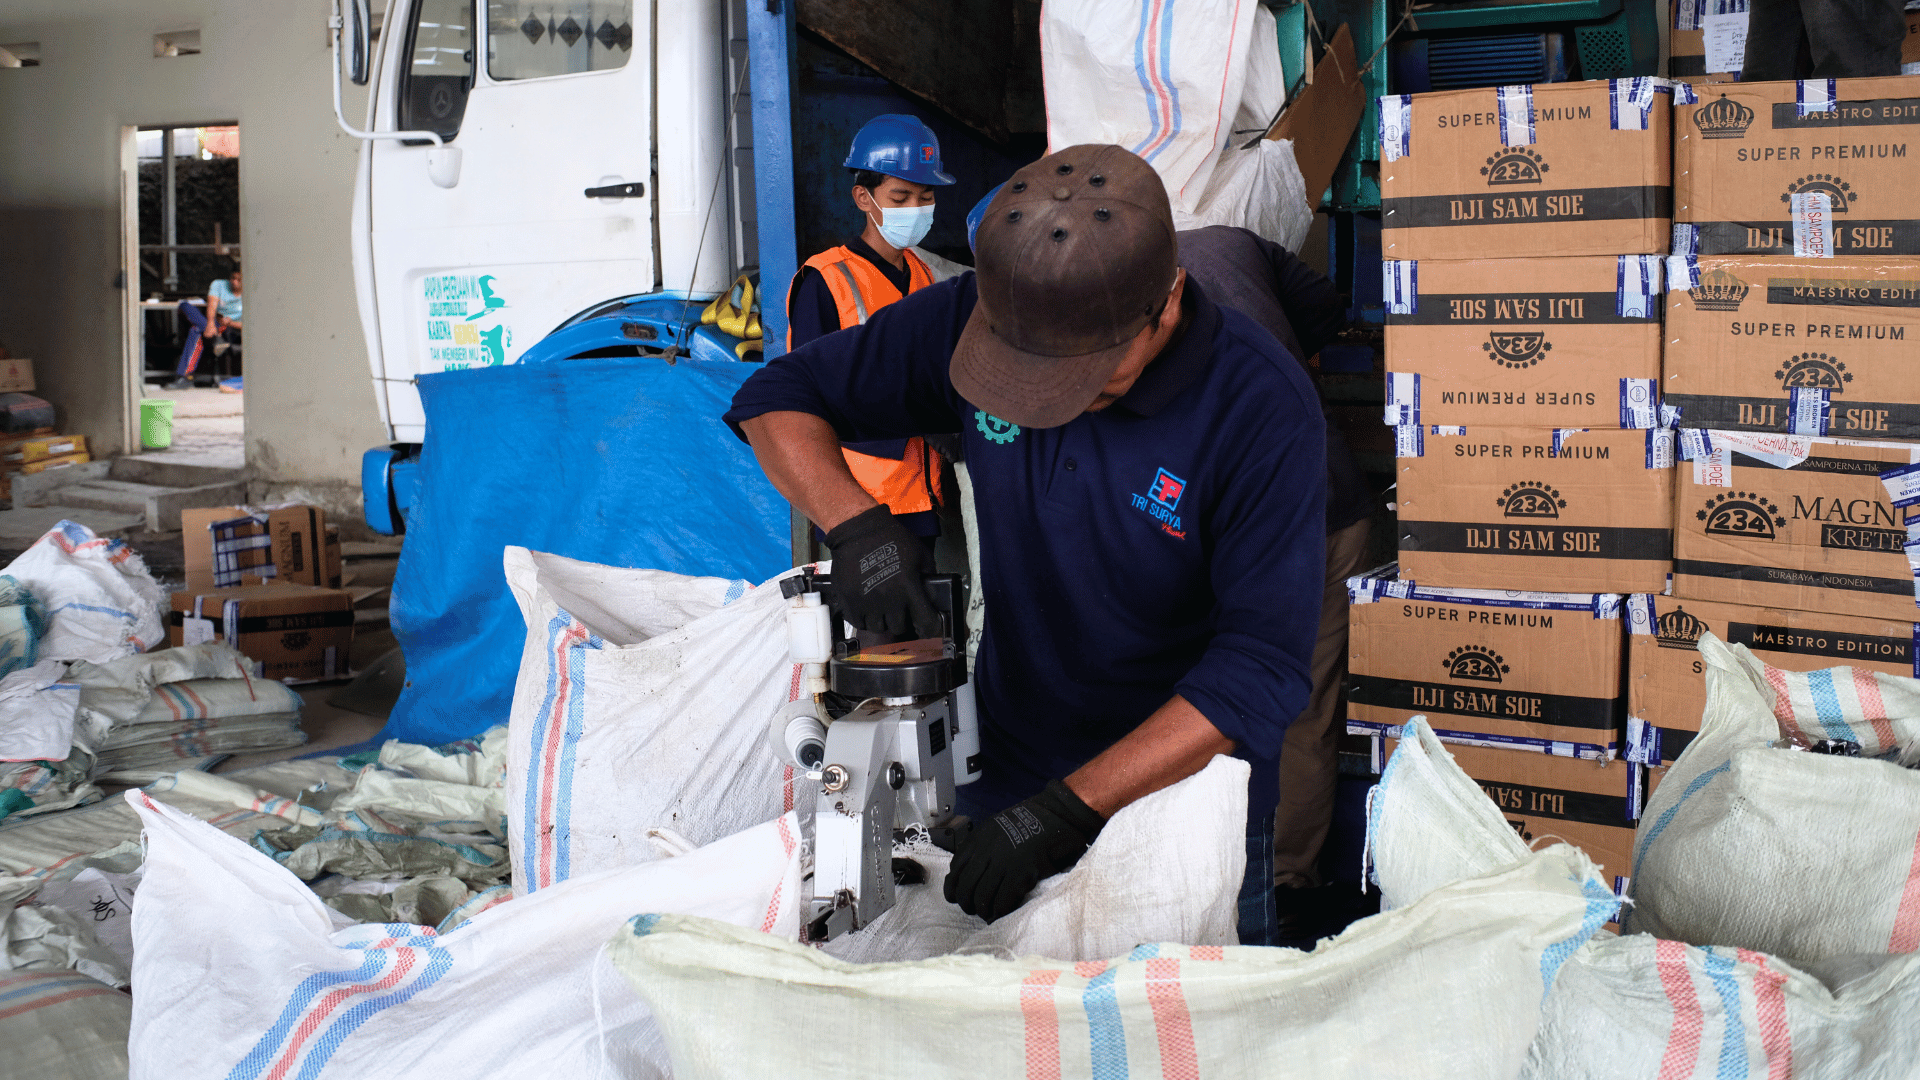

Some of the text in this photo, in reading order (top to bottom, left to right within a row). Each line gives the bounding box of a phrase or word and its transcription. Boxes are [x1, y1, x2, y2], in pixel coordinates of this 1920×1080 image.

[1438, 112, 1495, 128] SUPER
[1797, 107, 1872, 121] MAESTRO
[1737, 143, 1907, 162] SUPER PREMIUM
[1495, 161, 1534, 181] 234
[1450, 195, 1584, 221] DJI SAM SOE
[1746, 227, 1784, 249] DJI
[1851, 227, 1893, 248] SOE
[1793, 286, 1870, 299] MAESTRO
[1450, 298, 1584, 319] DJI SAM SOE
[1731, 322, 1905, 340] SUPER PREMIUM
[1498, 336, 1538, 354] 234
[1791, 369, 1835, 388] 234
[1442, 391, 1595, 405] SUPER PREMIUM
[1739, 404, 1777, 427] DJI
[1846, 408, 1889, 431] SOE
[1455, 444, 1610, 459] SUPER PREMIUM
[1804, 459, 1862, 472] SAMPOERNA
[1132, 493, 1181, 530] TRI SURYA
[1511, 496, 1551, 514] 234
[1793, 495, 1908, 527] MAGN
[1714, 509, 1766, 532] 234
[1466, 528, 1600, 552] DJI SAM SOE
[1826, 528, 1905, 550] KRETE
[1767, 569, 1814, 582] SURABAYA
[1822, 574, 1874, 588] INDONESIA
[1403, 604, 1553, 628] SUPER PREMIUM
[1753, 631, 1905, 657] MAESTRO EDITION
[1457, 660, 1495, 678] 234
[1412, 686, 1542, 718] DJI SAM SOE
[1530, 791, 1565, 815] DJI
